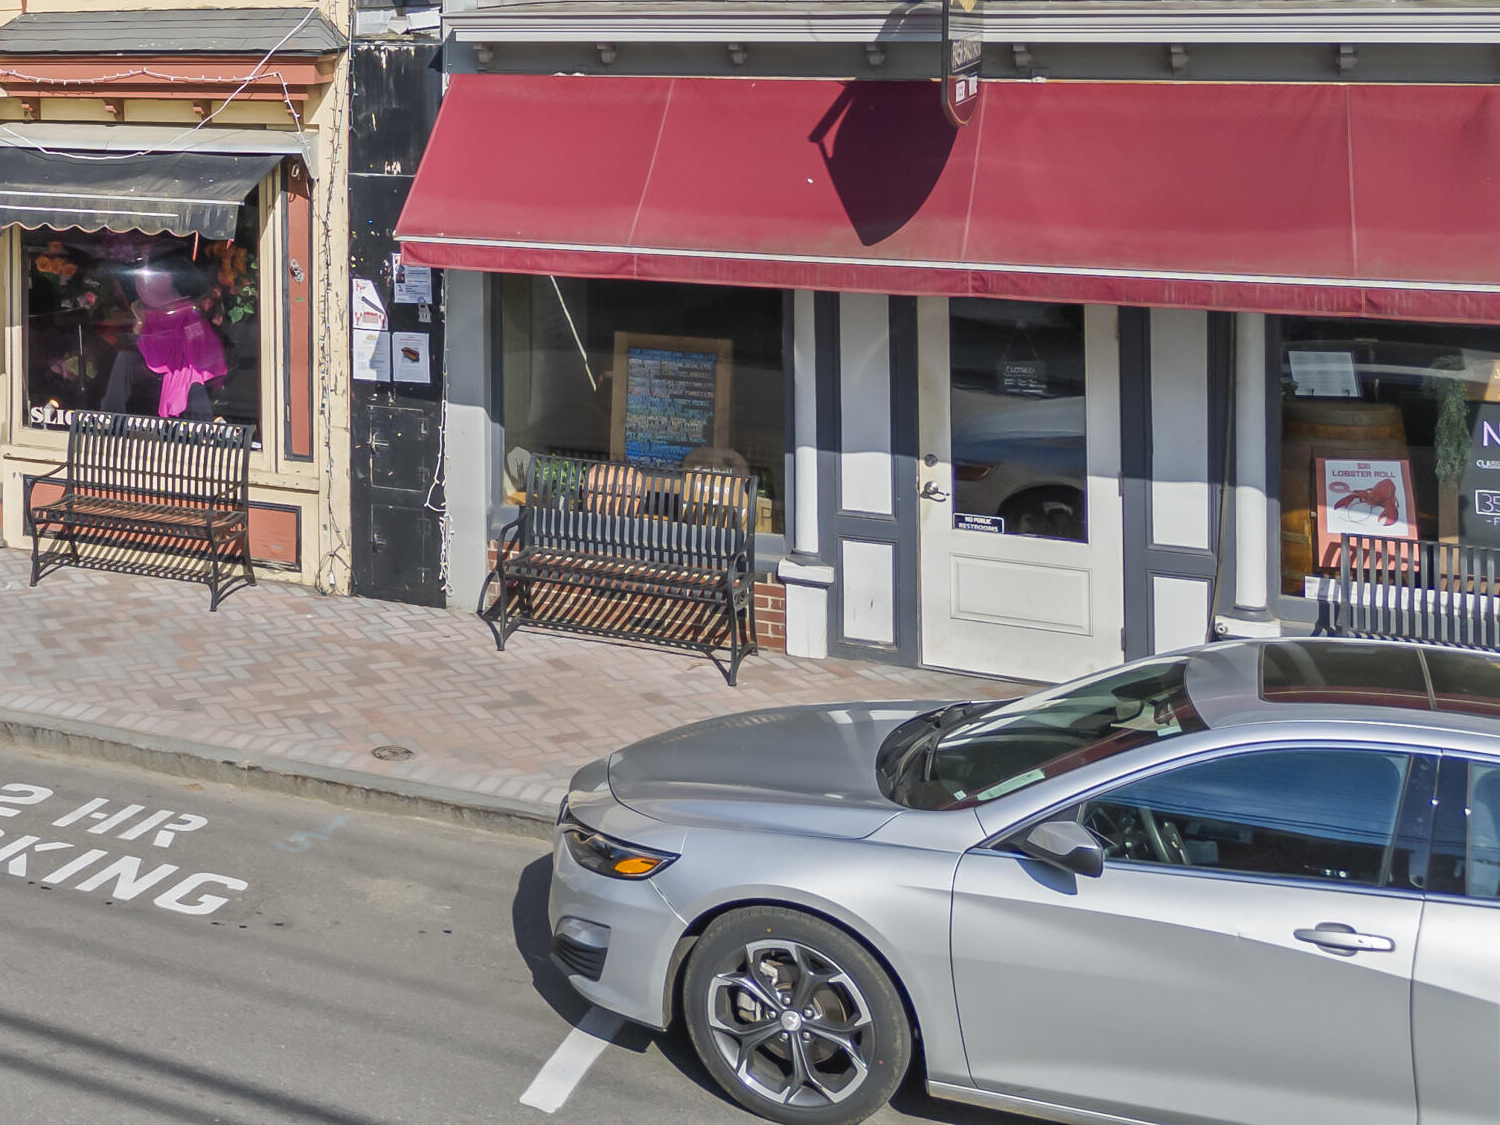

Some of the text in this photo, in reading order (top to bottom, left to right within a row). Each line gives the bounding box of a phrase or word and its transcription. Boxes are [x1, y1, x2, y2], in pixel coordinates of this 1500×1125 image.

[1482, 420, 1500, 447] N
[1332, 470, 1396, 479] LOBSTER ROLL
[974, 517, 992, 525] PUBLIC
[958, 522, 999, 532] RESTROOMS
[51, 796, 210, 849] HR
